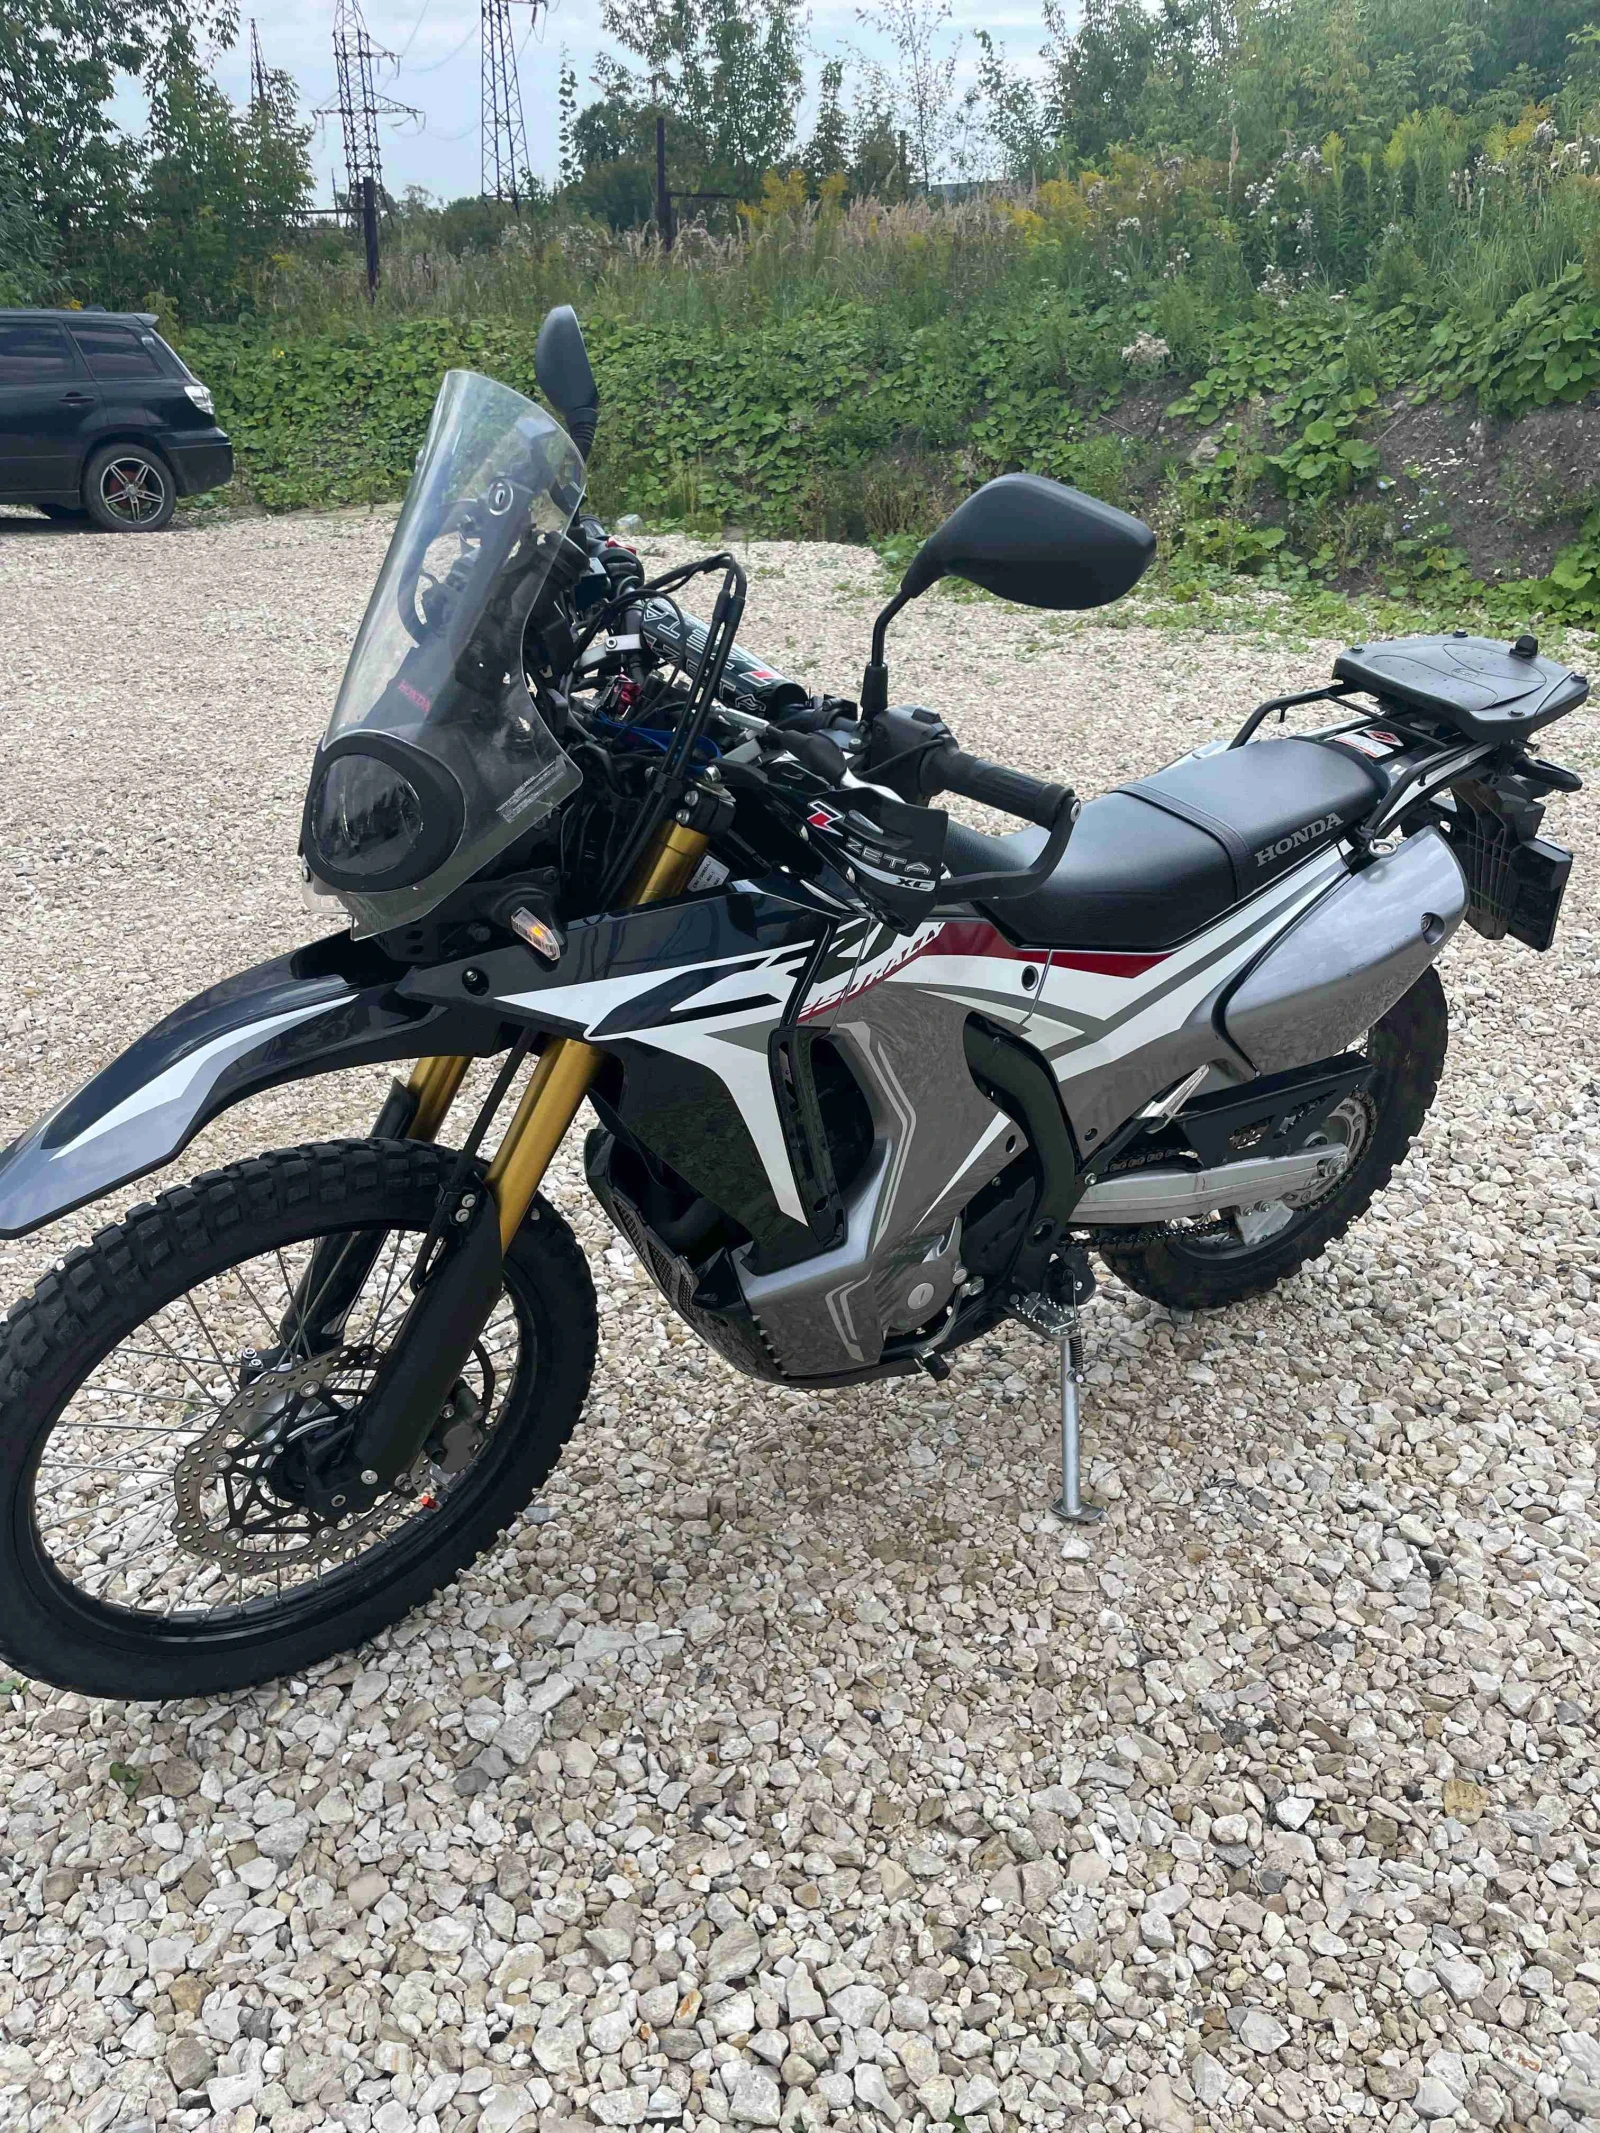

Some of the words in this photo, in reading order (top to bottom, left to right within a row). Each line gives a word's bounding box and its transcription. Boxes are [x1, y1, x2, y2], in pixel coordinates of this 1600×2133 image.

[845, 836, 932, 876] ZETA
[1254, 811, 1345, 867] HONDA
[896, 877, 934, 890] XC
